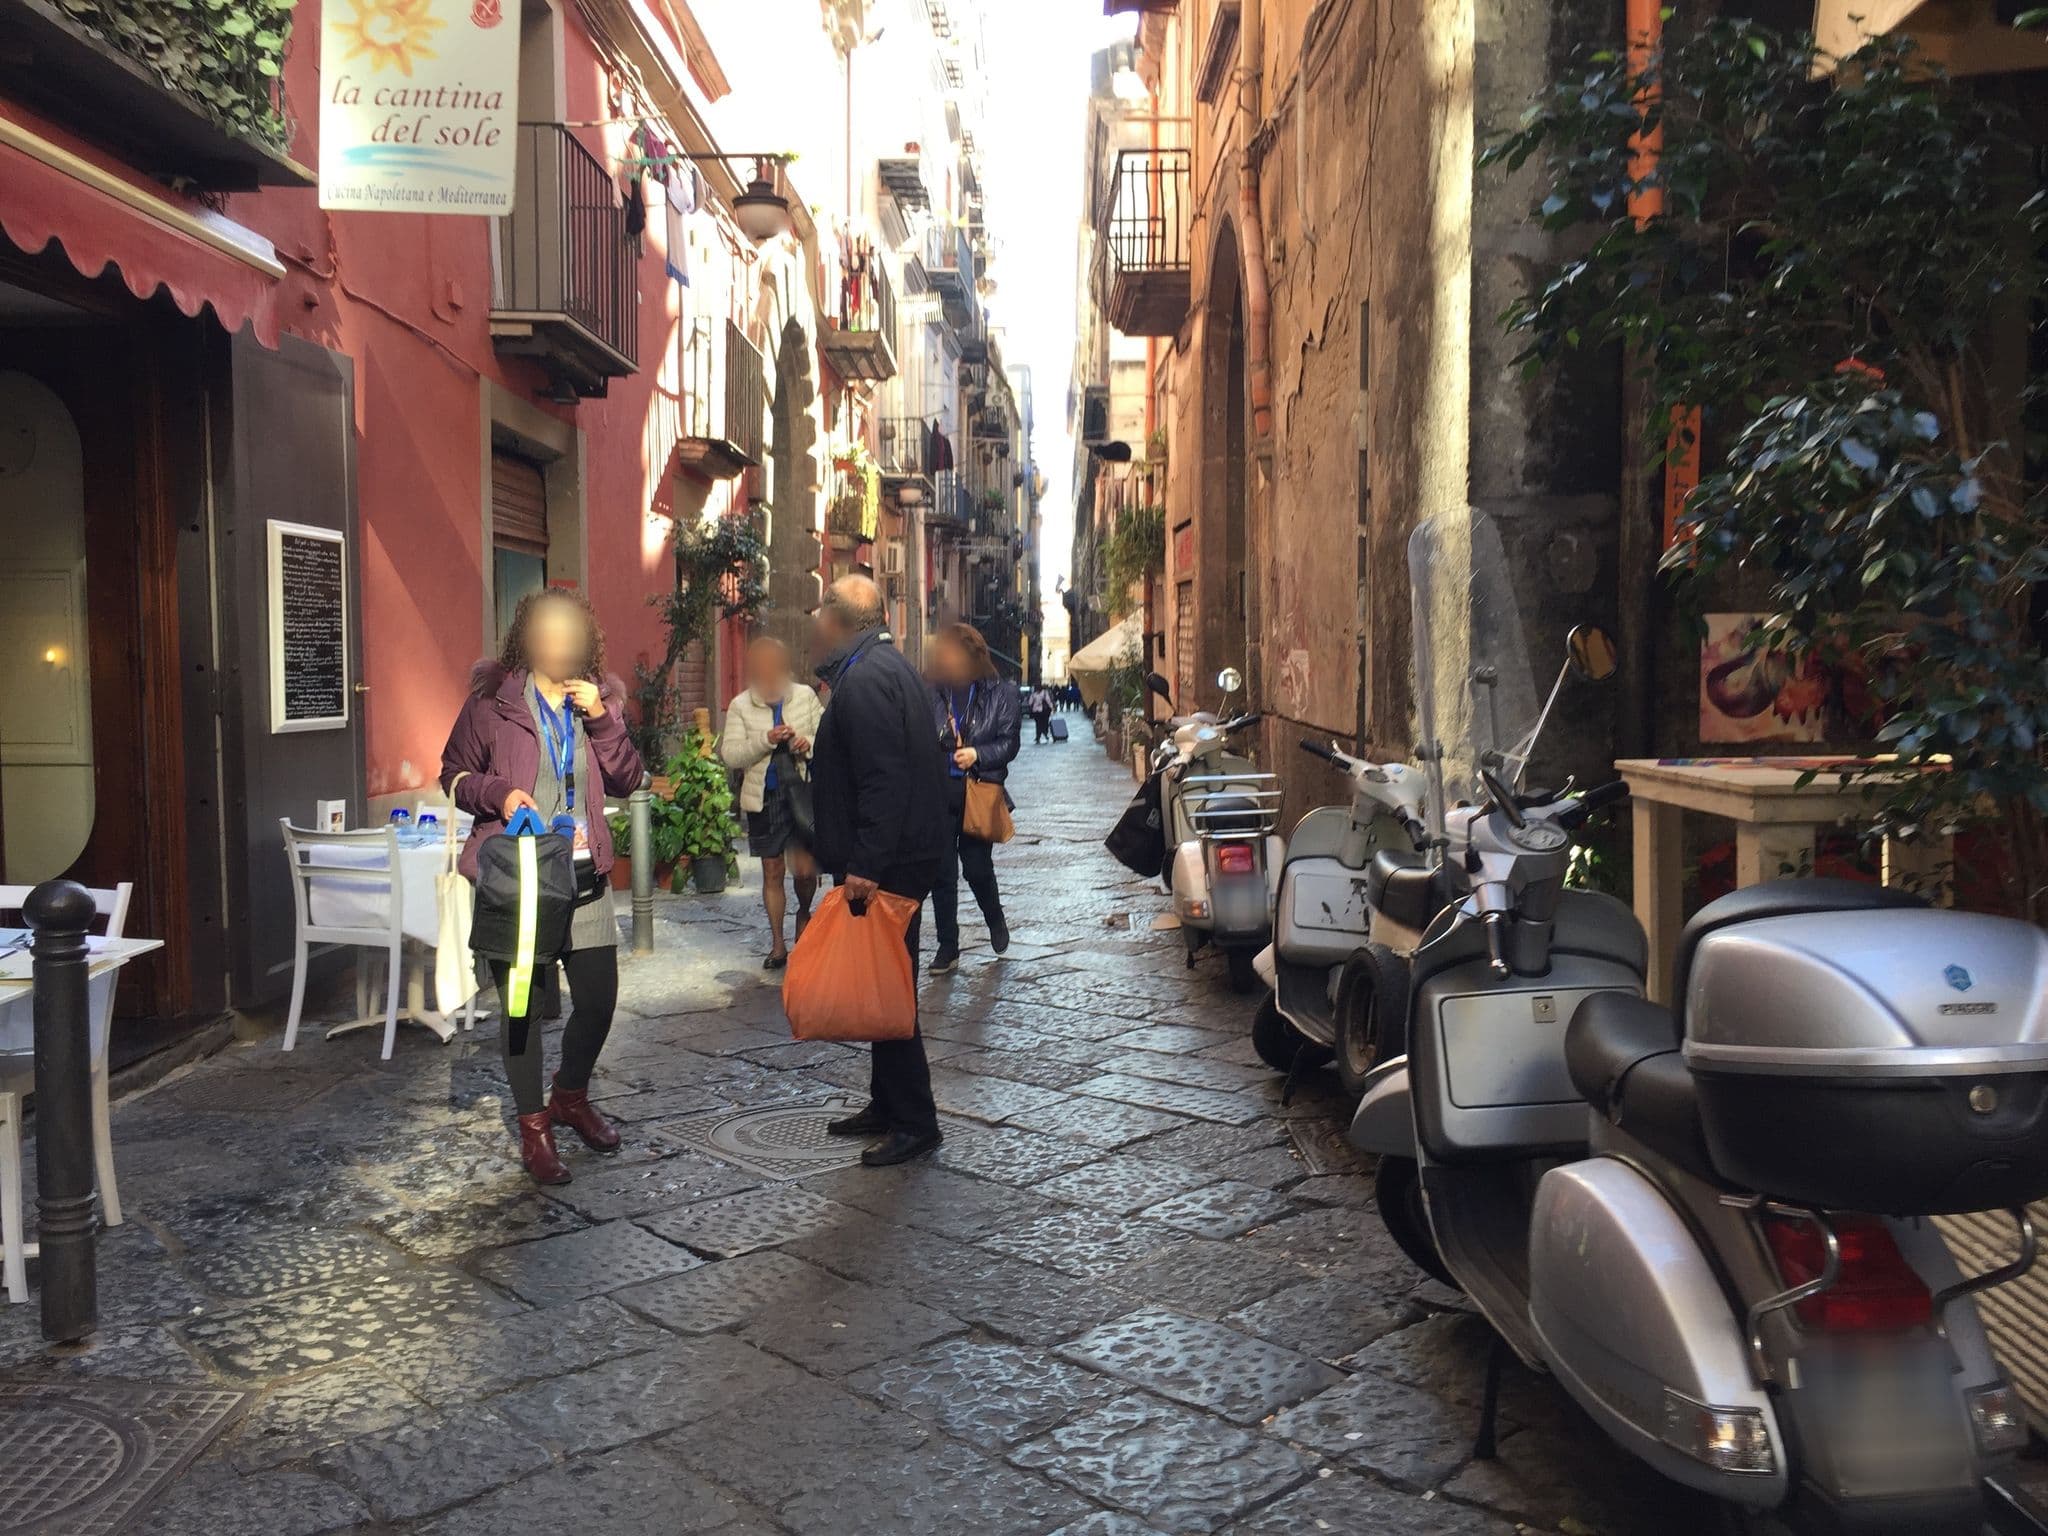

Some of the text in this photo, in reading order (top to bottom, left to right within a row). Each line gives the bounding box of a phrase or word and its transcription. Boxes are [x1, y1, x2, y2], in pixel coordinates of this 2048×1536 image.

[332, 75, 504, 110] la cantina
[371, 113, 501, 147] del sole
[327, 182, 507, 207] Cucina Napoletana e Mediterranea
